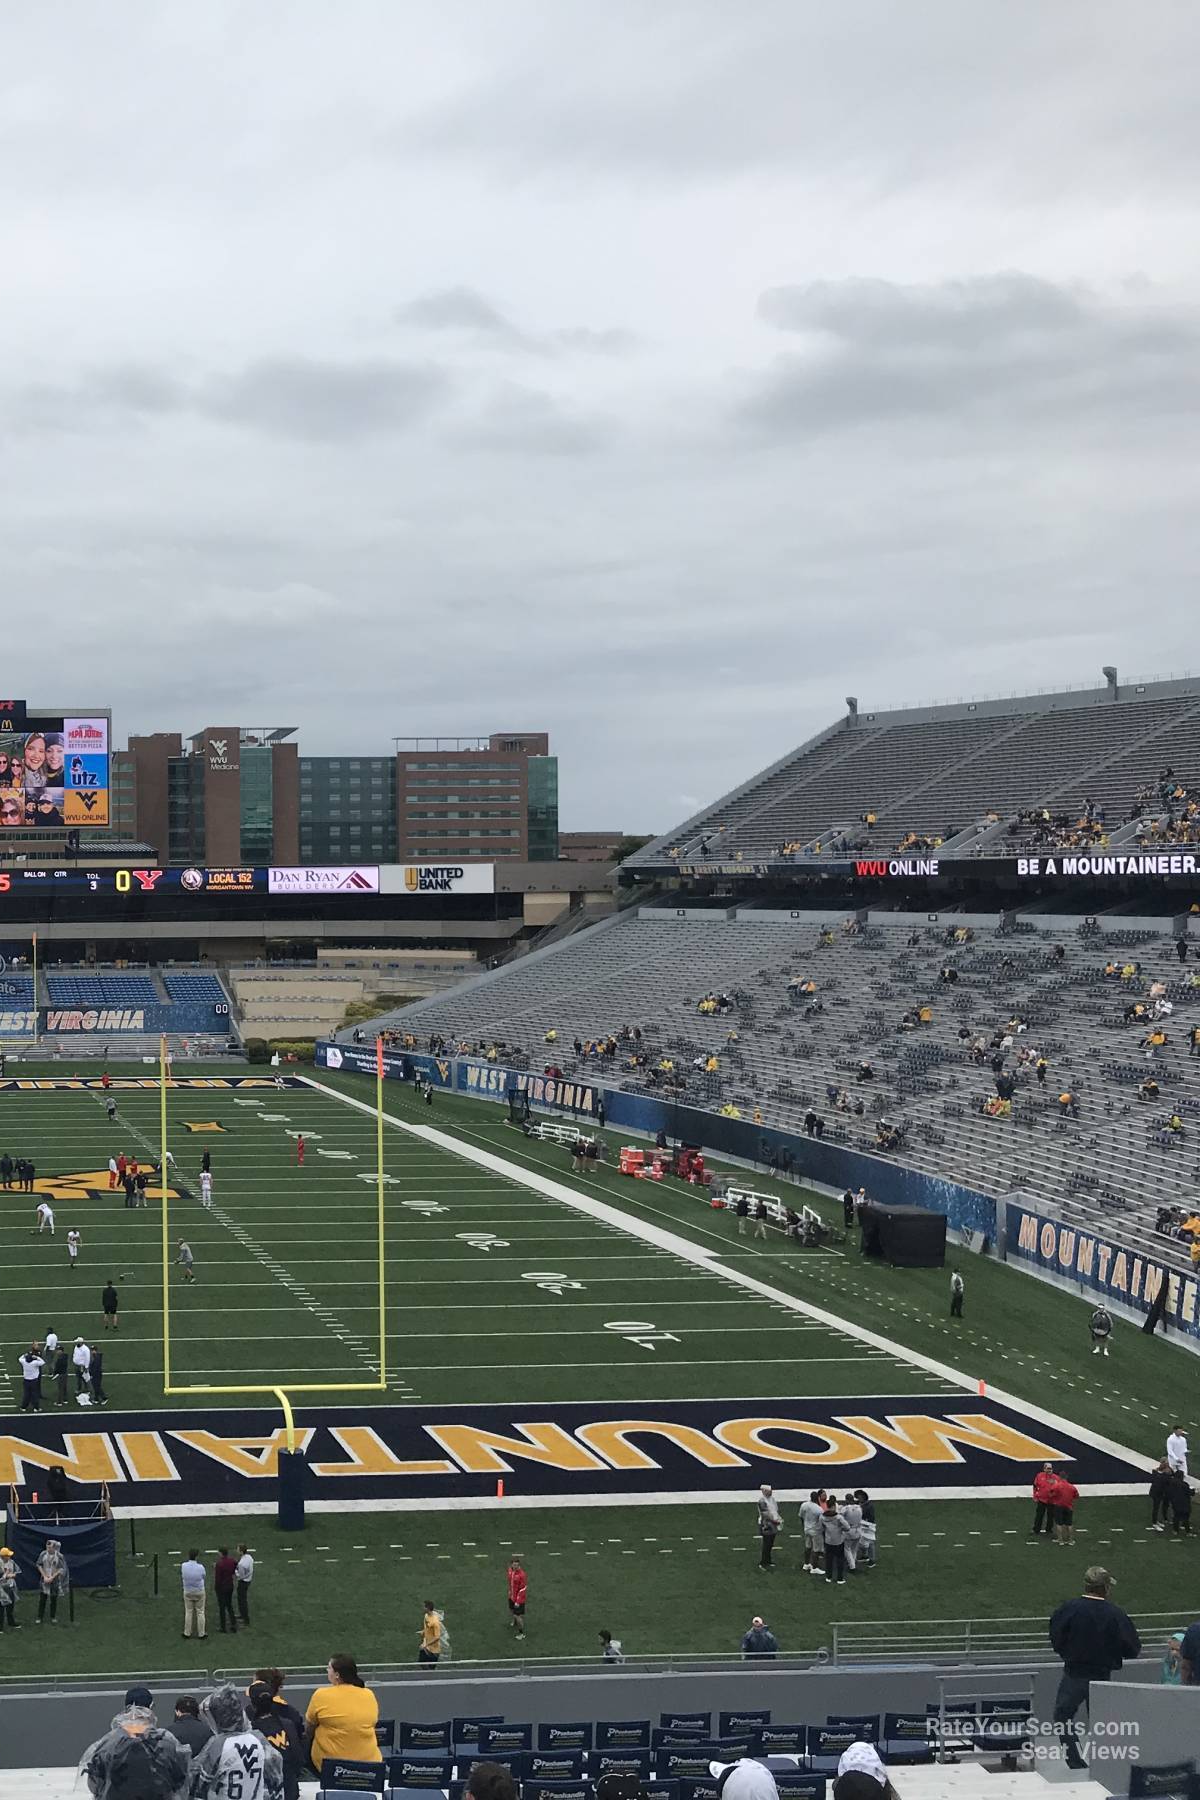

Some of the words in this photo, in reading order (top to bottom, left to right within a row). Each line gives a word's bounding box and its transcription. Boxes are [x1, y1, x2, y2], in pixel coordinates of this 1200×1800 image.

[68, 729, 83, 738] PAPA
[419, 867, 464, 879] UNITED
[856, 859, 887, 876] WVU
[888, 859, 939, 876] ONLINE
[1017, 858, 1040, 875] BE
[1044, 858, 1057, 875] A
[1062, 855, 1200, 875] MOUNTAINEER.
[115, 870, 130, 892] 0
[133, 870, 163, 890] Y
[208, 873, 236, 883] LOCAL
[237, 873, 253, 883] 152
[272, 870, 300, 883] DAN
[305, 870, 340, 882] RYAN
[419, 879, 452, 890] BANK
[90, 881, 98, 890] 3
[215, 1004, 229, 1014] 00
[46, 1010, 145, 1030] VIRGINIA
[466, 1066, 507, 1091] WEST
[516, 1074, 593, 1111] VIRGINIA
[455, 1233, 511, 1248] 30
[1017, 1213, 1200, 1323] MOUNTAINEE
[520, 1272, 587, 1290] 20
[603, 1321, 682, 1343] 10
[227, 1767, 262, 1800] 67
